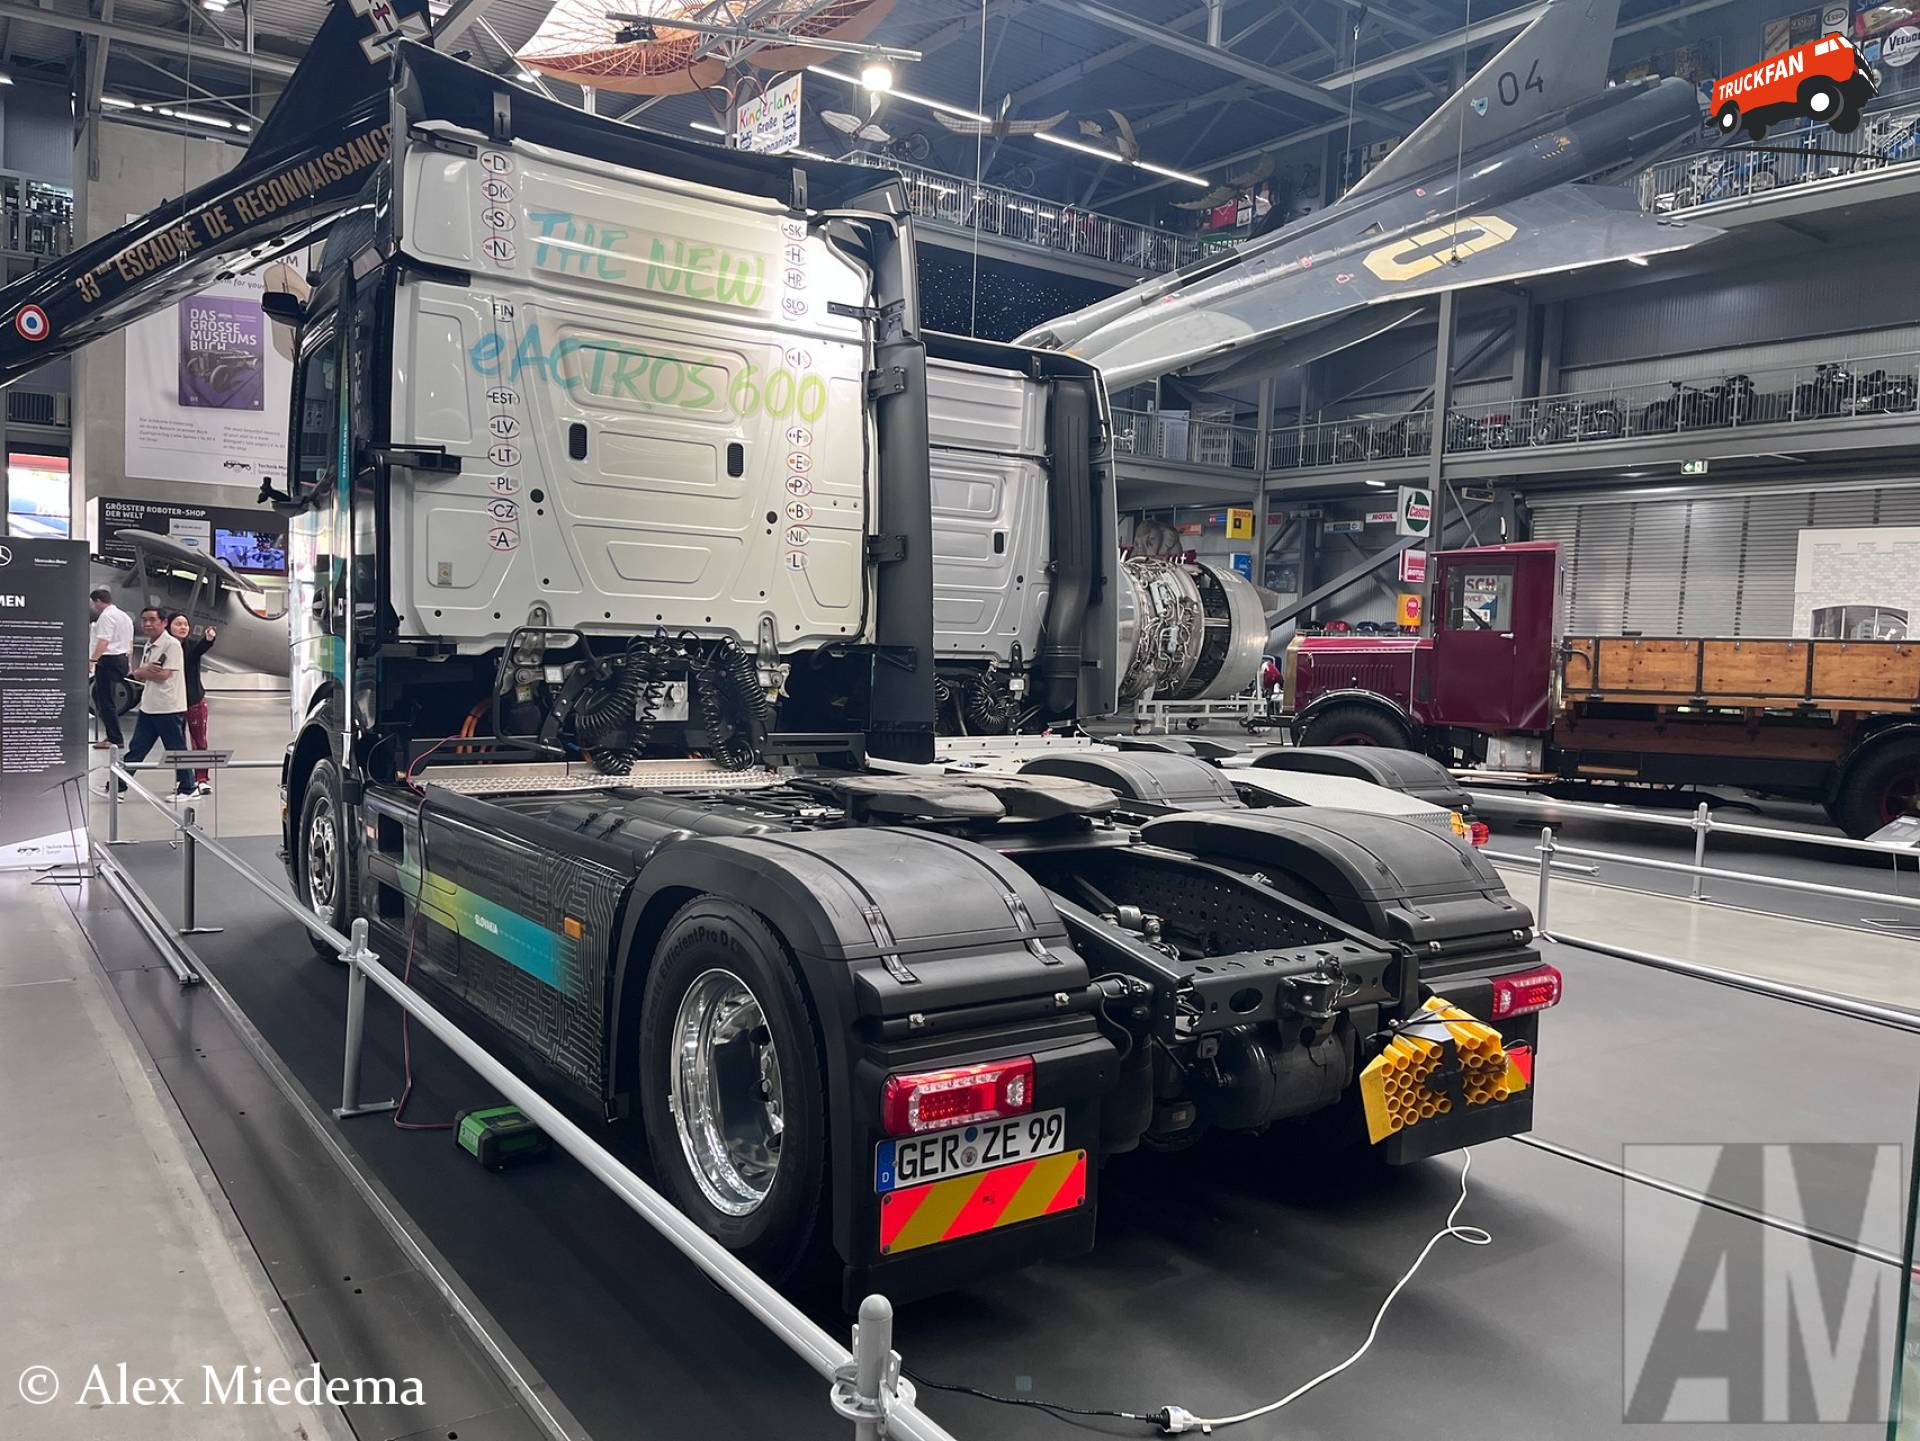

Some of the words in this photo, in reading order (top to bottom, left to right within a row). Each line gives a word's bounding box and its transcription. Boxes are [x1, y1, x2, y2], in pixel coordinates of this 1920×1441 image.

[1498, 59, 1544, 106] 04
[740, 78, 799, 129] Kinderland
[493, 155, 505, 171] D
[488, 183, 508, 199] DK
[493, 212, 504, 227] S
[788, 224, 802, 237] SK
[115, 221, 202, 281] ESCADRE
[201, 206, 234, 239] DE
[493, 241, 506, 257] N
[528, 211, 630, 280] THE
[646, 239, 764, 306] NEW
[791, 247, 801, 262] H
[493, 304, 514, 318] FIN
[786, 298, 806, 312] SLO
[190, 308, 216, 321] DAS
[190, 321, 241, 334] GROSSE
[190, 331, 257, 346] MUSEUMS
[190, 341, 226, 351] BUCH
[470, 324, 715, 409] eACTROS
[729, 365, 827, 424] 600
[492, 392, 512, 404] EST
[497, 421, 513, 433] LV
[796, 430, 803, 444] F
[498, 448, 512, 462] LT
[796, 455, 803, 469] E
[497, 477, 512, 491] PL
[794, 479, 803, 493] P
[105, 502, 145, 513] GRÖSSTER
[146, 506, 206, 517] ROBOTER-SHOP
[105, 510, 121, 518] DER
[123, 511, 144, 519] WELT
[494, 505, 514, 518] CZ
[796, 503, 804, 518] B
[496, 534, 510, 548] A
[790, 526, 804, 542] NL
[793, 554, 800, 567] L
[898, 1134, 959, 1181] GER
[981, 1122, 1020, 1163] ZE
[1028, 1114, 1062, 1153] 99
[881, 1172, 889, 1183] D
